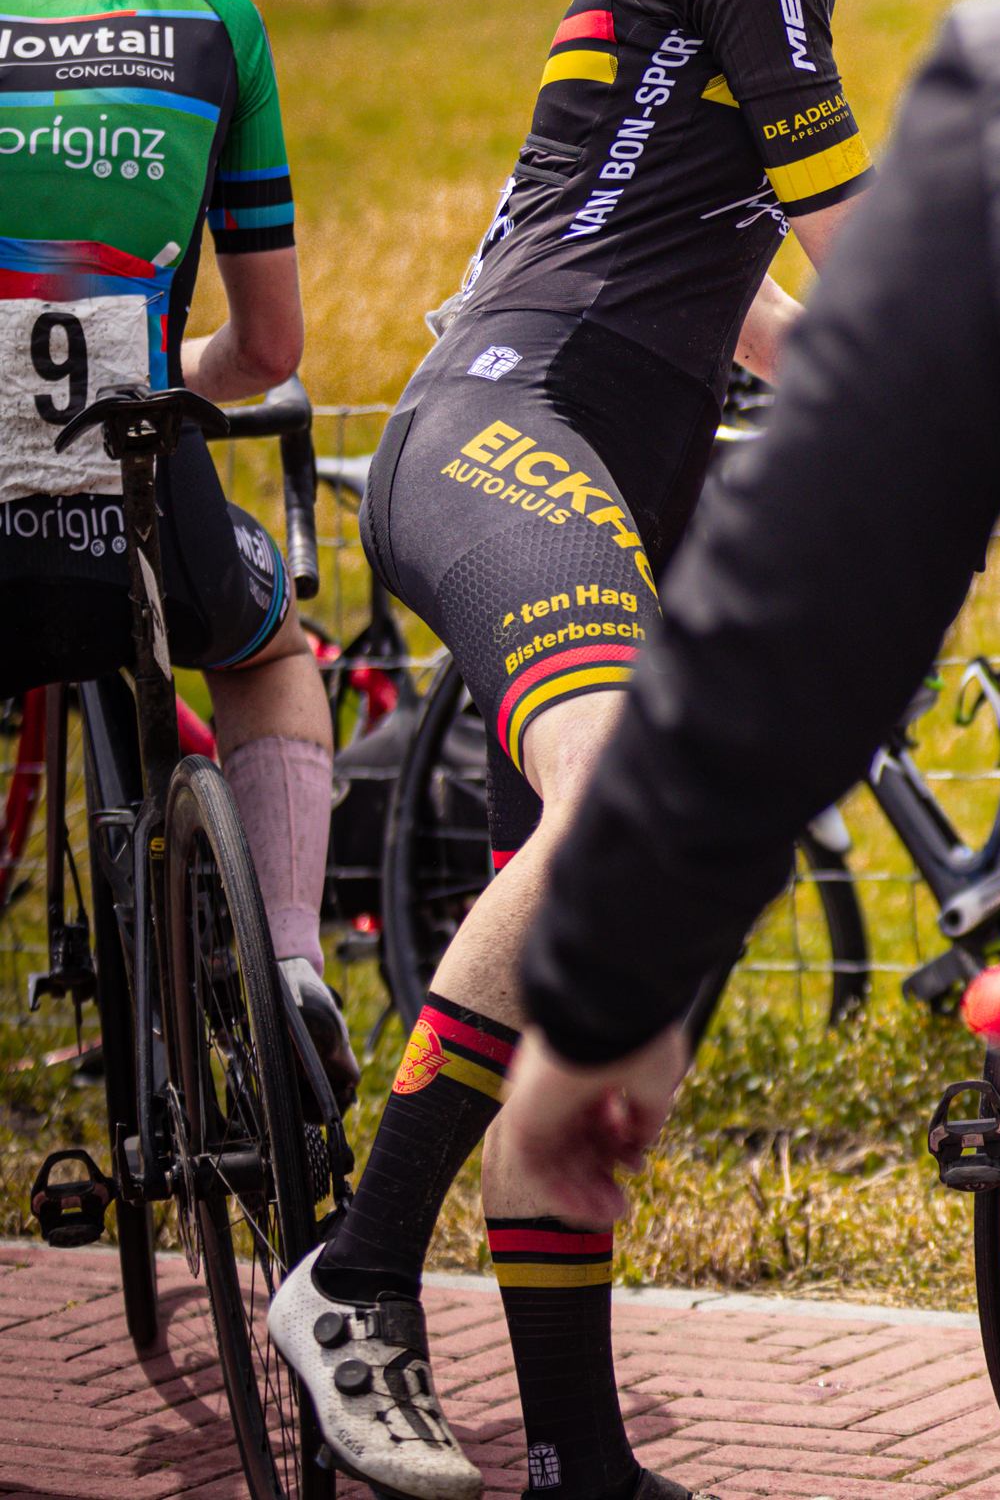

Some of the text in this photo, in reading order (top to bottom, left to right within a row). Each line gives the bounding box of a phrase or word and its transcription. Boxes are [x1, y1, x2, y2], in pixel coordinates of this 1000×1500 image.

[56, 64, 175, 82] CONCLUSION
[562, 28, 705, 240] VAN BON-SPOR
[763, 119, 791, 140] DE
[791, 110, 850, 142] APELDOORN
[30, 312, 89, 426] 9
[441, 459, 572, 525] AUTOHUIS
[520, 584, 637, 624] ten Hag
[504, 622, 645, 676] Bisterbosch
